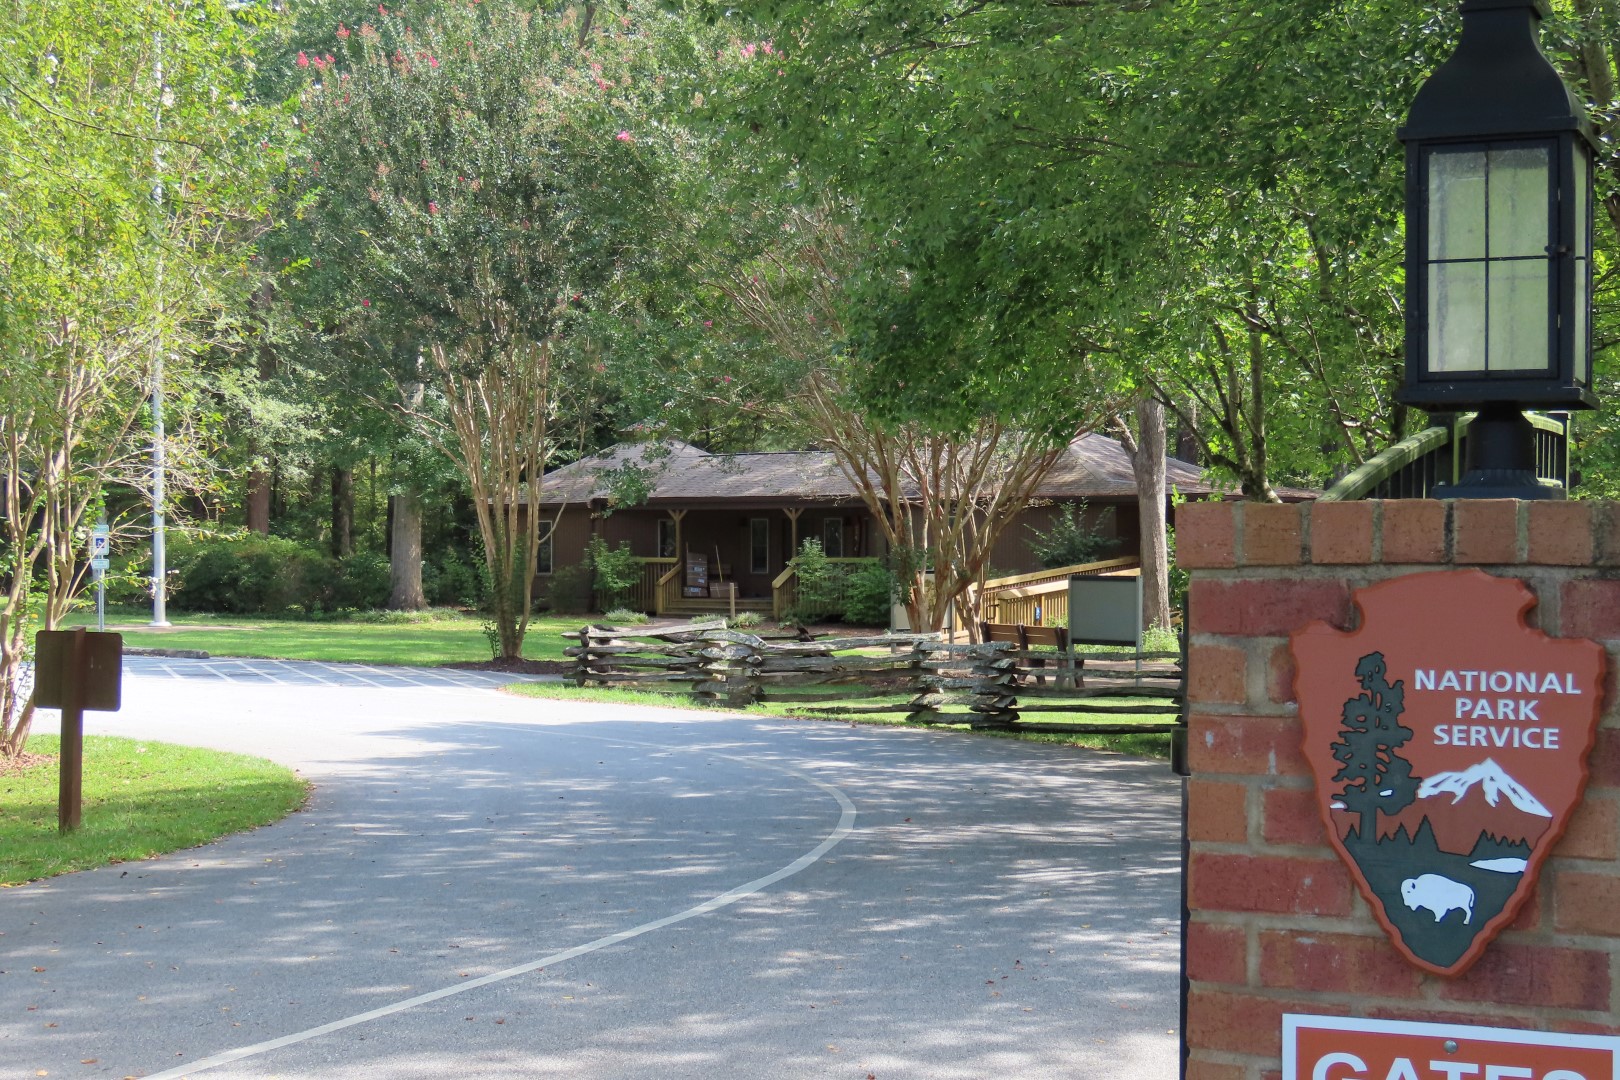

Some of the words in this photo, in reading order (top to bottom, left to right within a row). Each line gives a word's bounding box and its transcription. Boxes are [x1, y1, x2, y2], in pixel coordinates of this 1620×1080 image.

[1414, 669, 1581, 694] NATIONAL
[1455, 697, 1539, 721] PARK
[1433, 725, 1559, 749] SERVICE
